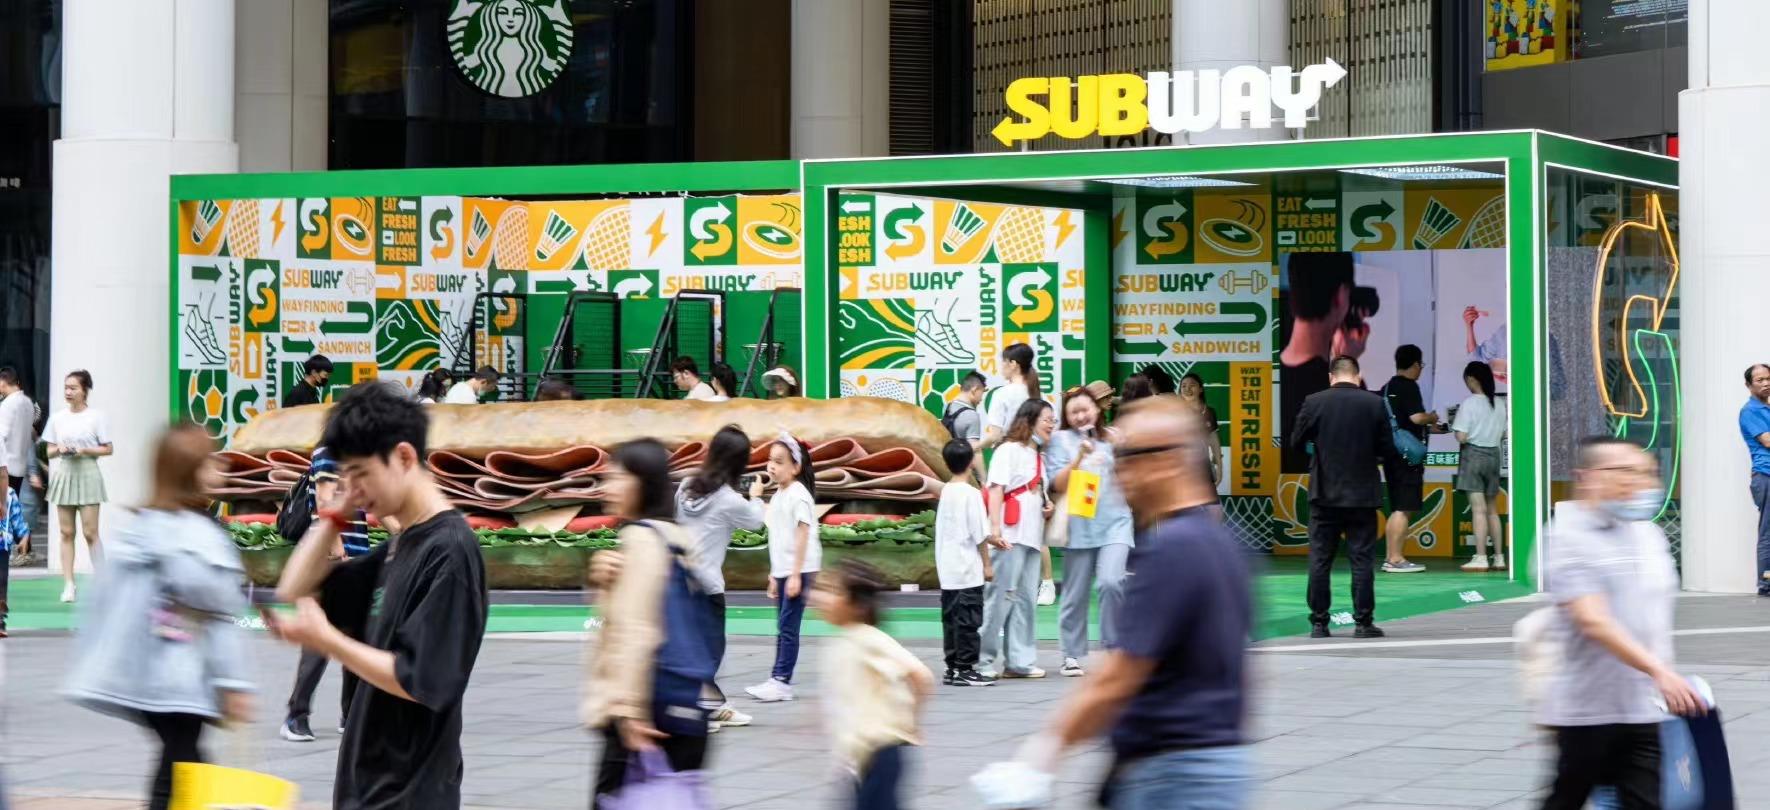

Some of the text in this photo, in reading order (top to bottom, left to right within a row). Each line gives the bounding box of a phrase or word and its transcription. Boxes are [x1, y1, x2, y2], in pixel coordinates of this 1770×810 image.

[991, 56, 1348, 147] SUBWAY
[1277, 197, 1302, 211] EAT
[382, 214, 417, 229] FRESH
[839, 216, 871, 231] ESH
[1277, 213, 1336, 229] FRESH
[395, 231, 417, 246] LOOK
[839, 232, 870, 248] OOK
[1298, 230, 1336, 245] LOOK
[382, 247, 417, 262] FRESH
[839, 248, 871, 263] ESH
[282, 268, 344, 289] SUBWAY
[411, 273, 467, 293] SUBWAY
[662, 274, 756, 295] SUBWAY
[866, 270, 964, 292] SUBWAY
[1114, 271, 1215, 295] SUBWAY
[282, 301, 345, 314] WAYFINDING
[1114, 302, 1217, 317] WAYFINDING
[229, 261, 241, 378] SUBWAY
[978, 266, 998, 376] SUBWAY
[1158, 322, 1169, 335] A
[318, 341, 371, 354] SANDWICH
[1171, 340, 1261, 354] SANDWICH
[1036, 334, 1054, 394] WAY
[1240, 367, 1261, 375] WAY
[265, 335, 277, 410] BWAY
[1241, 376, 1261, 387] TO
[1241, 389, 1261, 401] EAT
[1241, 403, 1261, 489] FRESH
